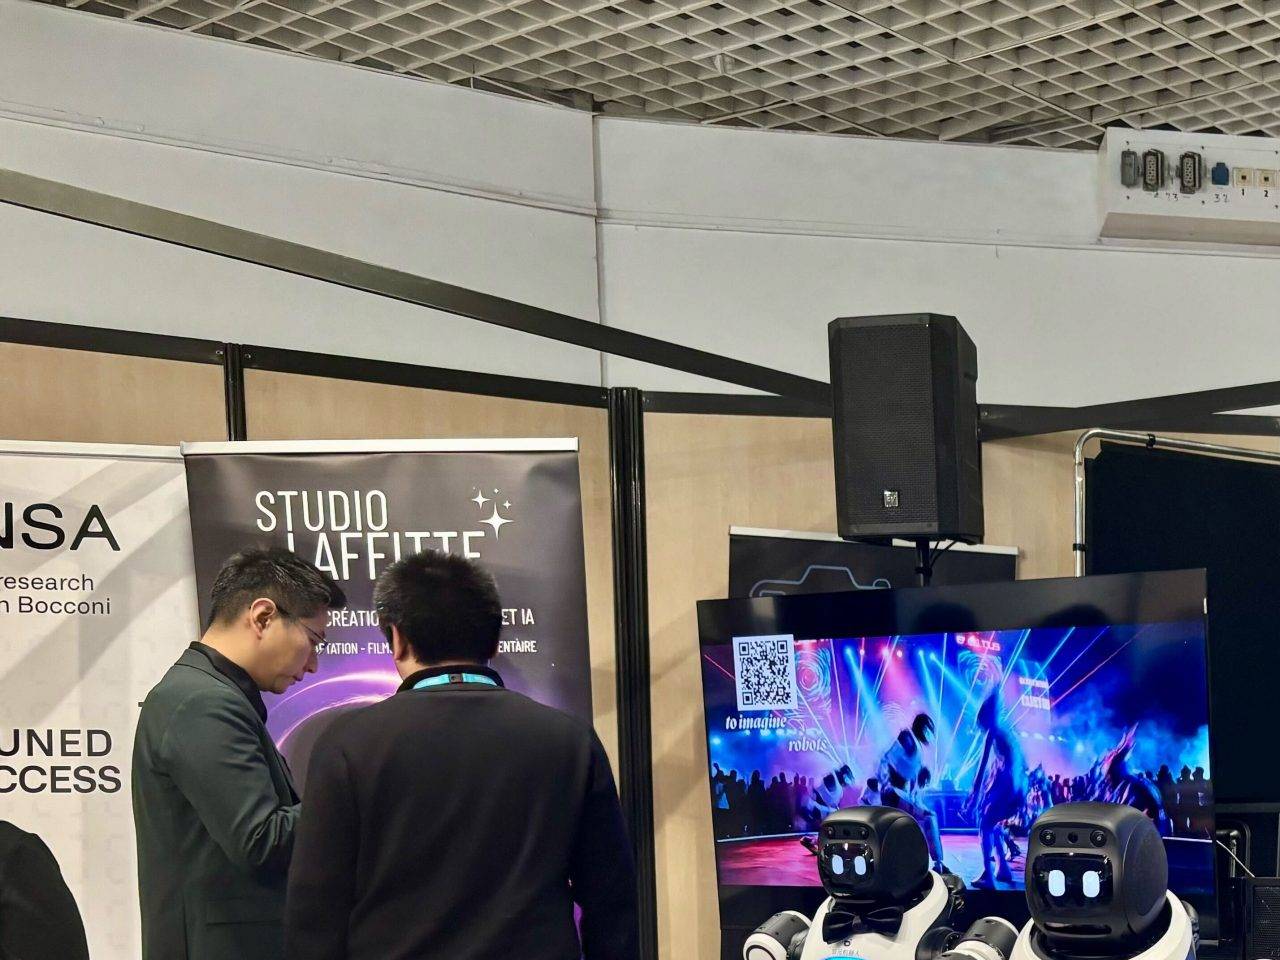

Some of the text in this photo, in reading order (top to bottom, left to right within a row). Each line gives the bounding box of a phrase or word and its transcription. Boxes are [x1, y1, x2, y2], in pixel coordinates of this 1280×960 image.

[255, 490, 388, 532] STUDIO
[18, 596, 110, 615] Bocconi
[501, 608, 518, 625] ET
[521, 608, 535, 625] IA
[367, 642, 393, 655] FILM
[725, 713, 787, 732] to imagine
[788, 736, 828, 752] robots
